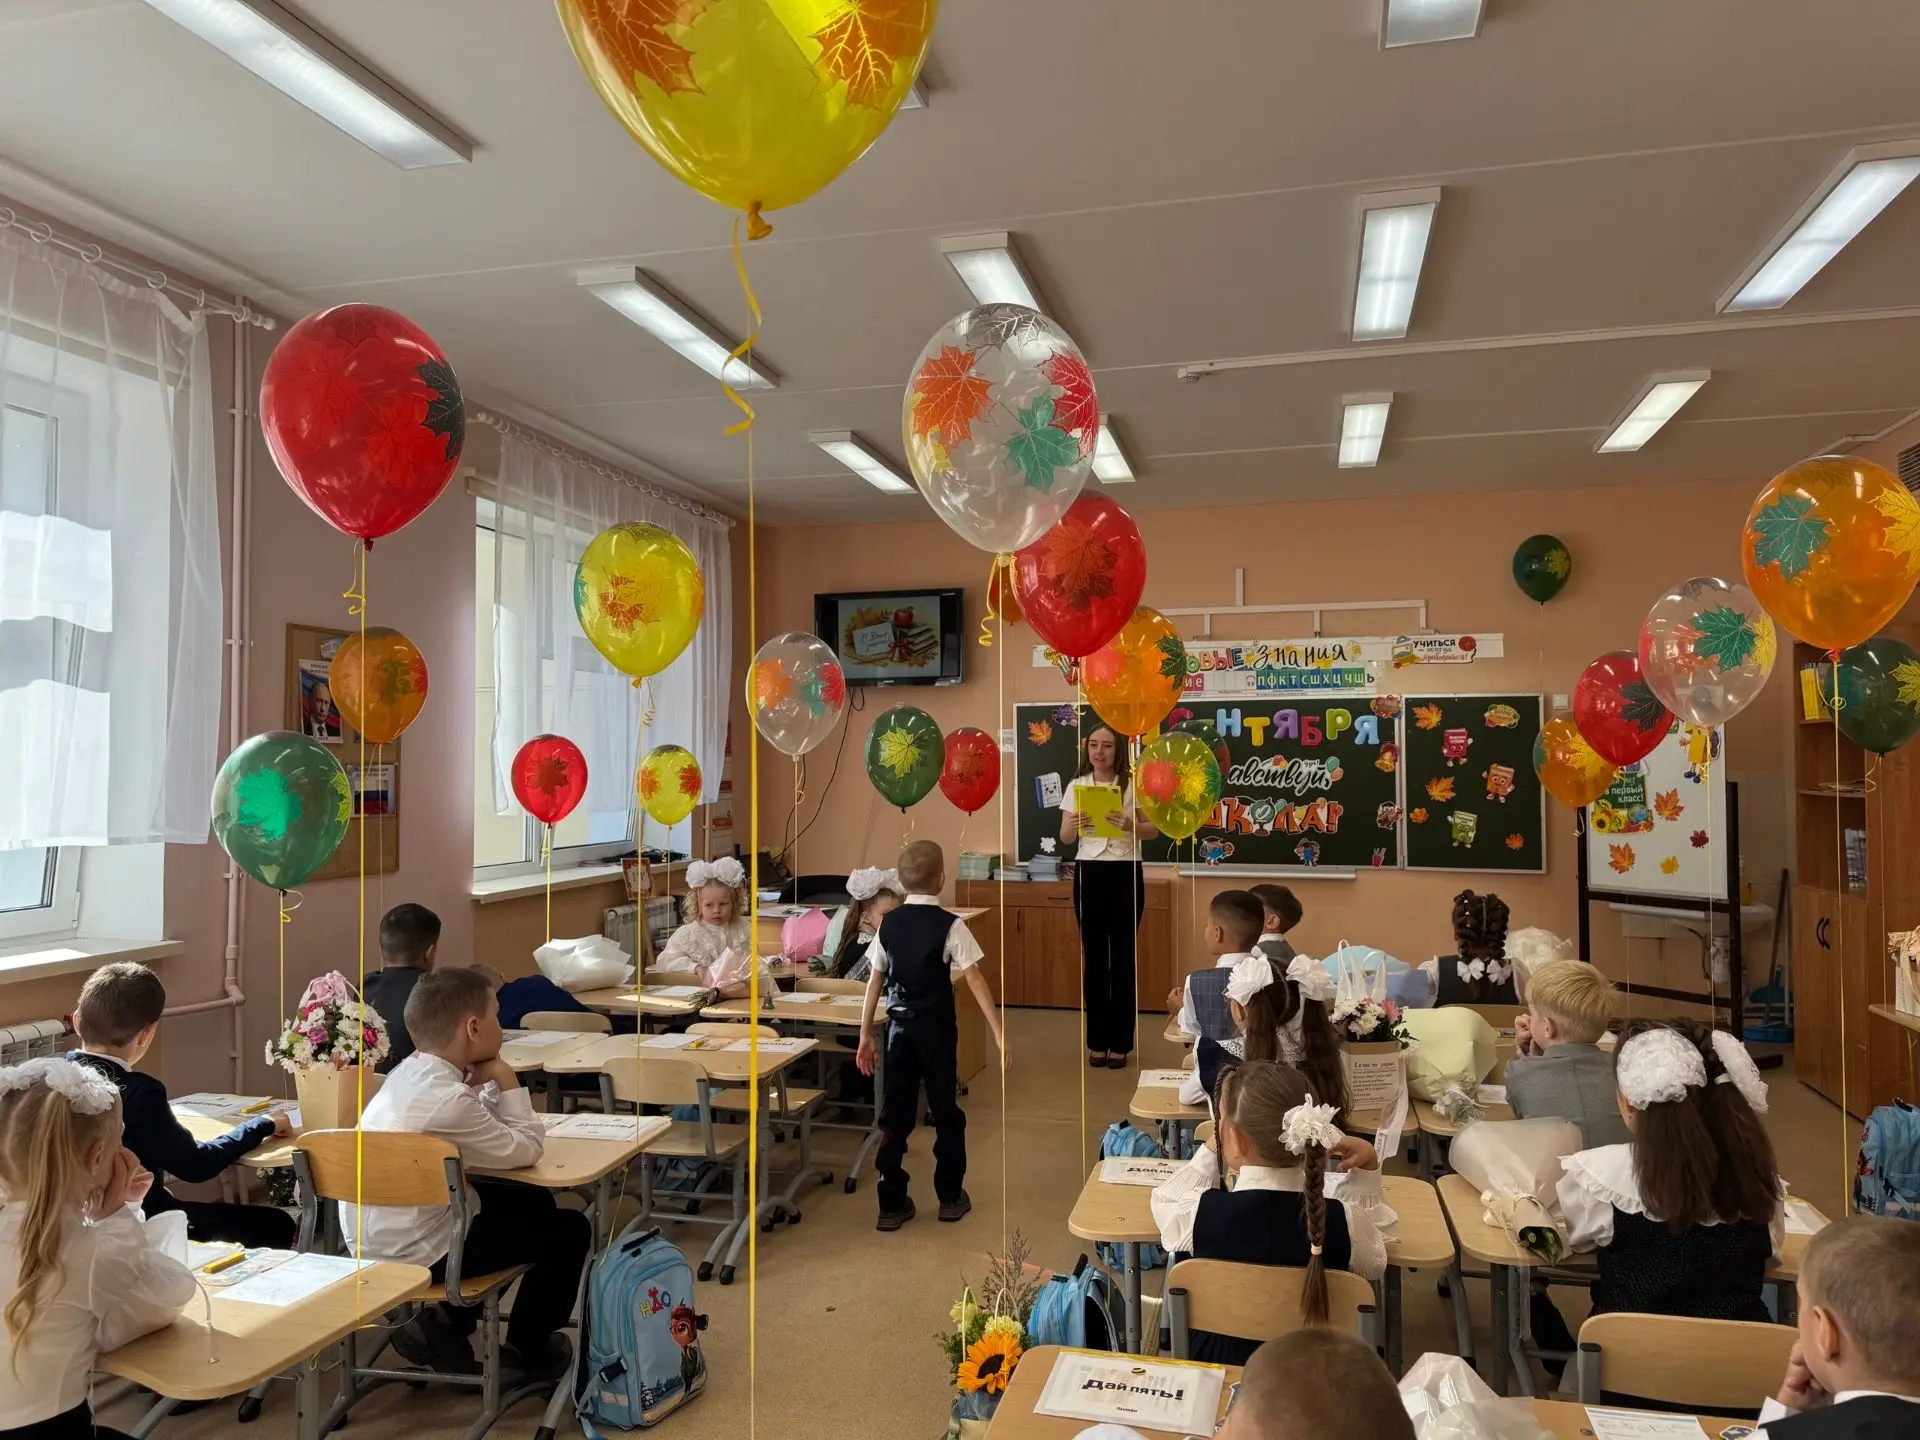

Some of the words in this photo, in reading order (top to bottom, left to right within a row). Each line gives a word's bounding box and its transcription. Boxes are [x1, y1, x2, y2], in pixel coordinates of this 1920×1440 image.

[1413, 639, 1456, 648] УЧИТЬСЯ
[1186, 647, 1244, 673] ОВЫЕ
[1168, 707, 1380, 747] СНТЯБРЯ
[1228, 759, 1331, 796] авствуй,
[1611, 785, 1643, 795] первый
[1618, 794, 1644, 803] класс!
[1082, 1379, 1127, 1391] Дай
[1130, 1386, 1184, 1401] пять!
